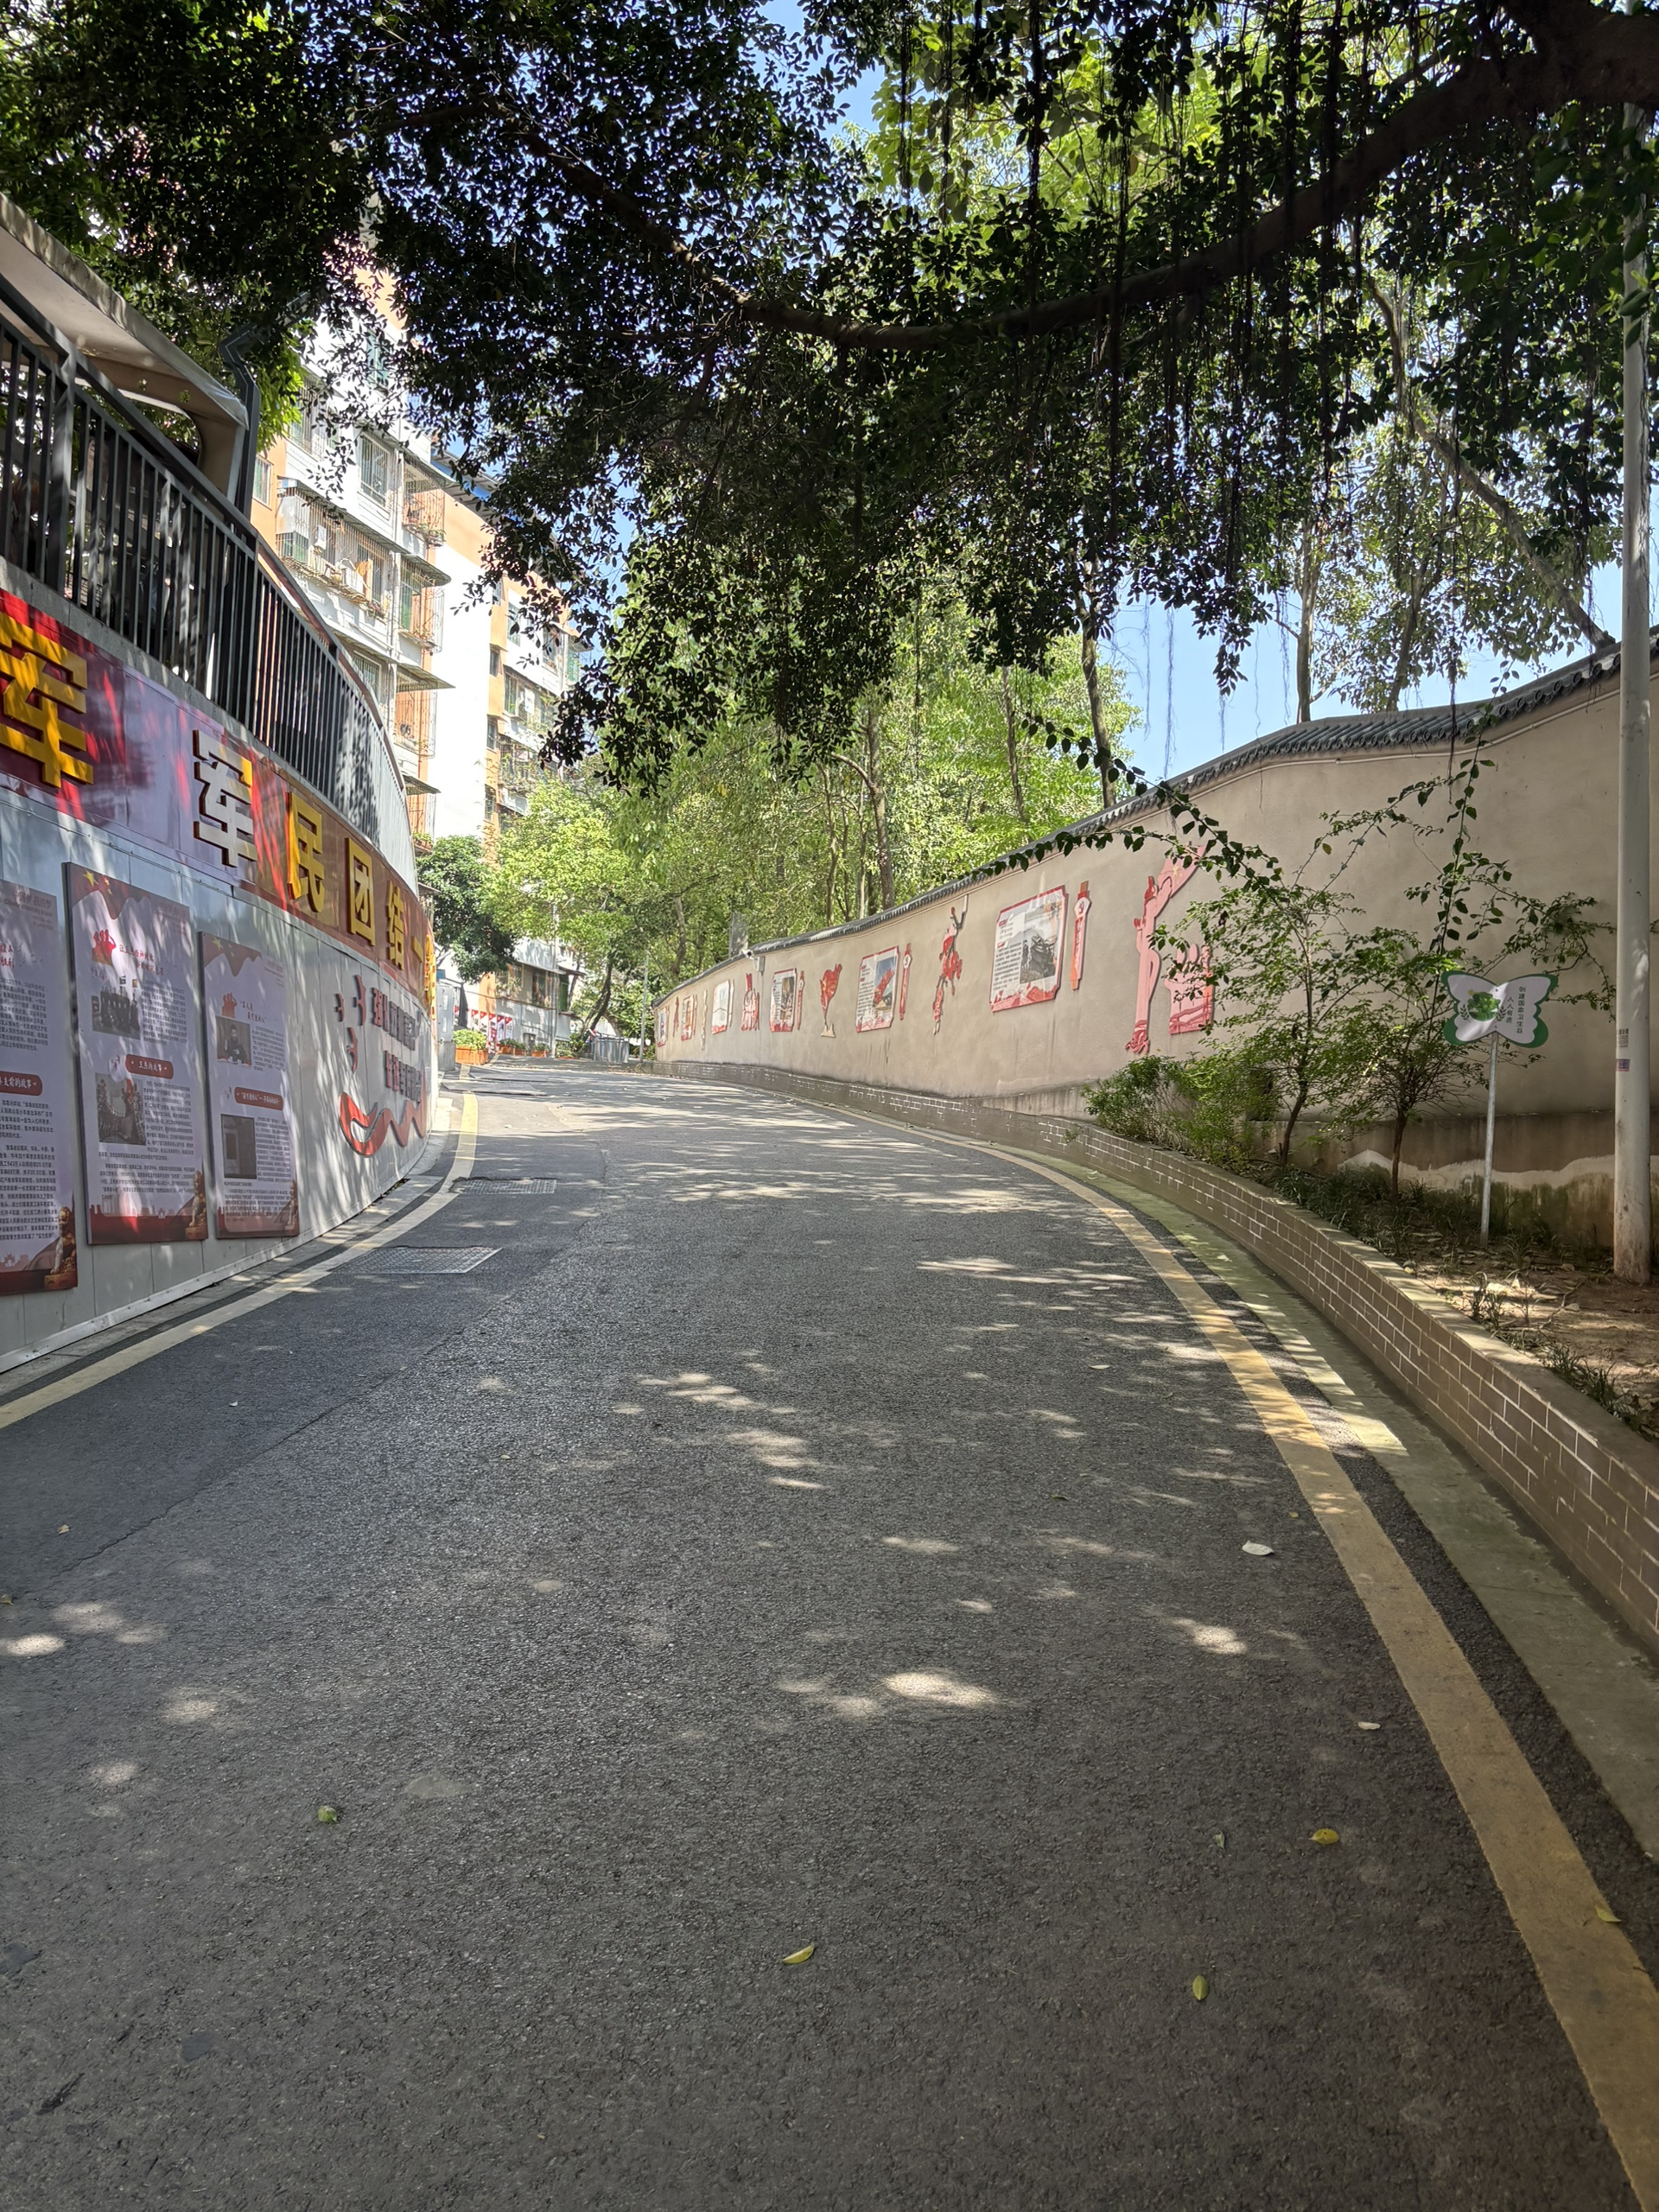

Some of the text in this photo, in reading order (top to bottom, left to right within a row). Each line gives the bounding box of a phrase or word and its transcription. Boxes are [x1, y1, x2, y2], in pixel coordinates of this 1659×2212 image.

[0, 615, 435, 1020] 军 军民团结一
[0, 1076, 32, 1089] 支前的故事
